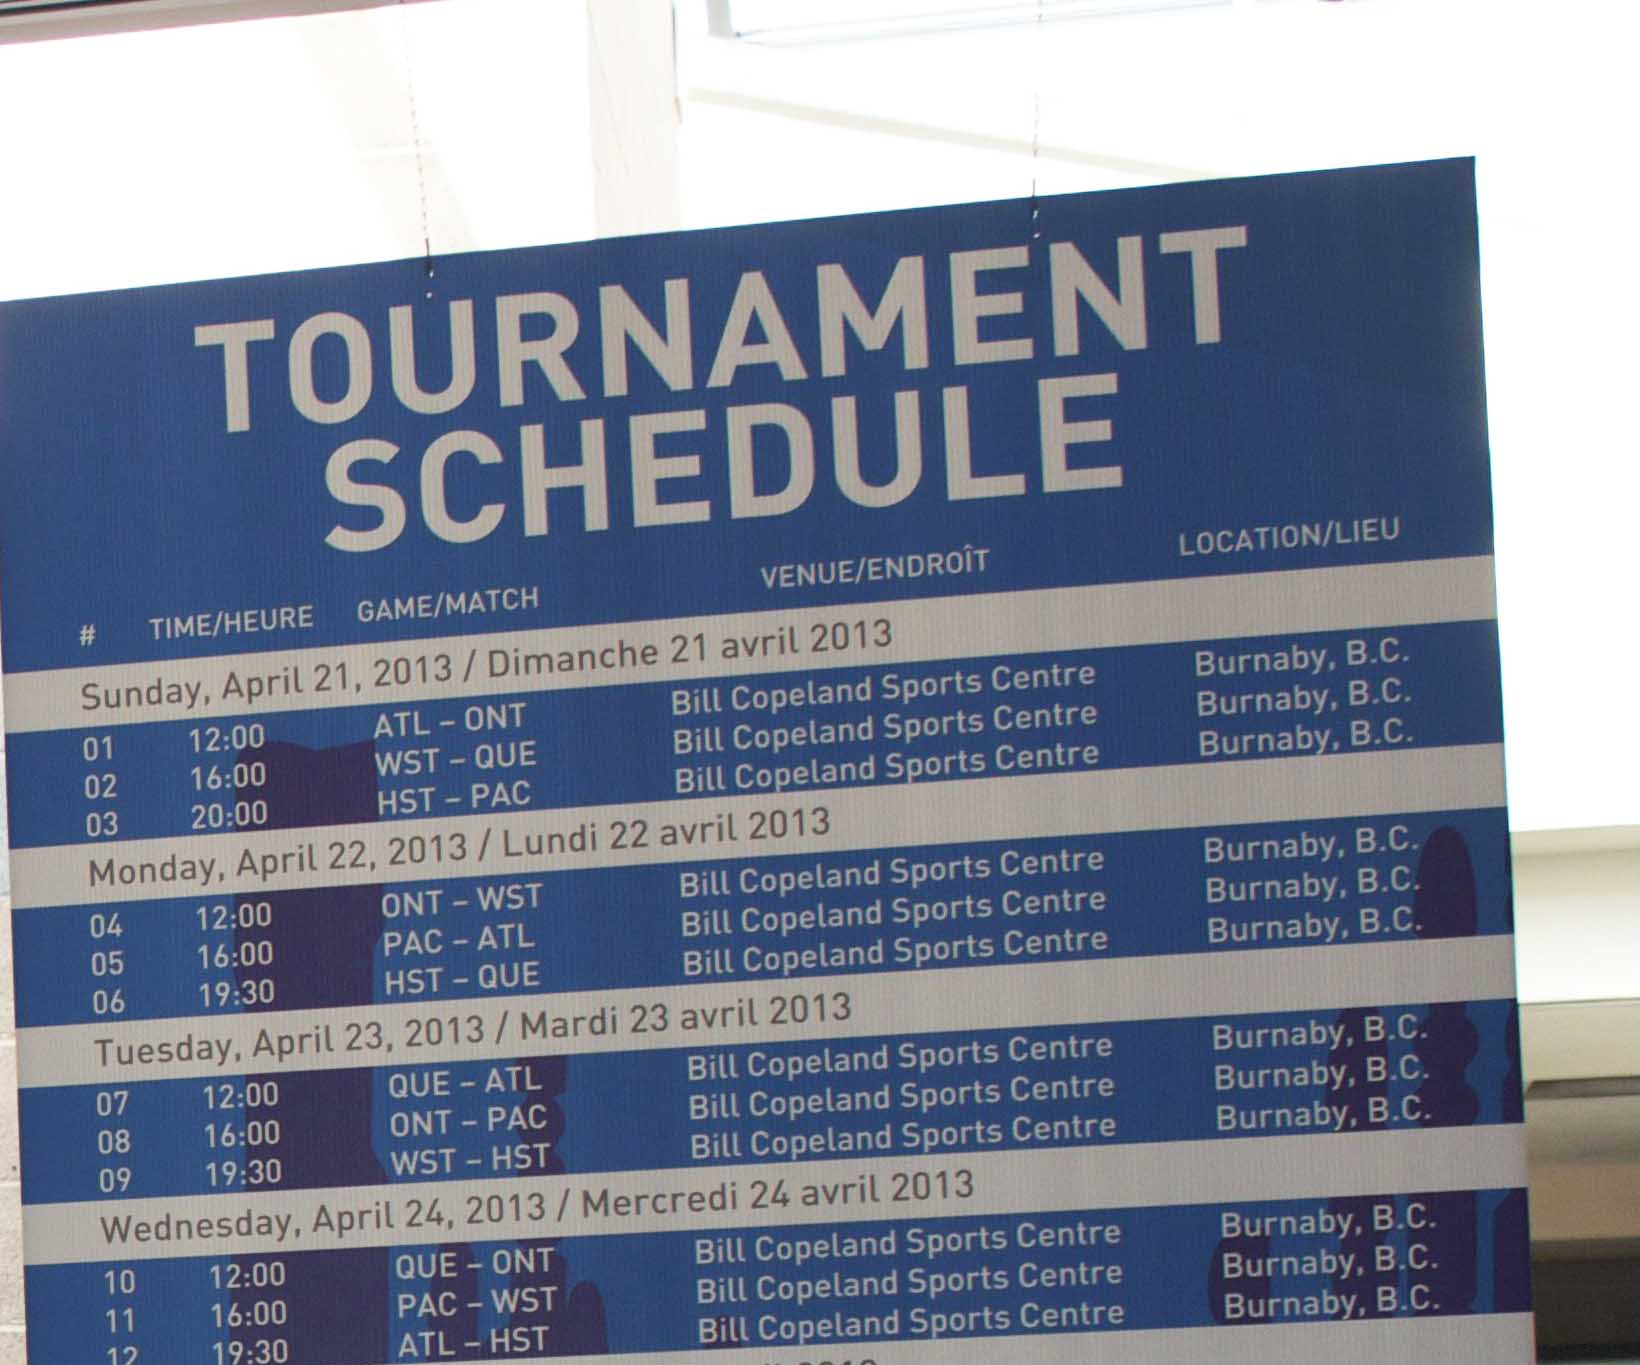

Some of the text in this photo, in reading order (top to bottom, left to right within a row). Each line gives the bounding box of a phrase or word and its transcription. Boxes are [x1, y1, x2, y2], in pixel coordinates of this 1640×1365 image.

[195, 227, 1246, 432] TOURNAMENT
[325, 373, 1122, 552] SCHEDULE
[1179, 517, 1399, 556] LOCATION/LIEU
[761, 549, 989, 588] VENUE/ENDROÎT
[149, 605, 313, 639] TIME/HEURE
[357, 587, 538, 622] GAME/MATCH
[80, 625, 95, 645] #
[82, 619, 891, 710] Sunday, April 21, 2013 / Dimanche 21 avril 2013
[1195, 637, 1408, 676] Burnaby, B.C.
[672, 664, 1095, 715] Bill Copeland Sports Centre
[190, 724, 264, 752] 12:00
[374, 711, 430, 738] ATL
[465, 703, 525, 731] ONT
[83, 736, 111, 761] 01
